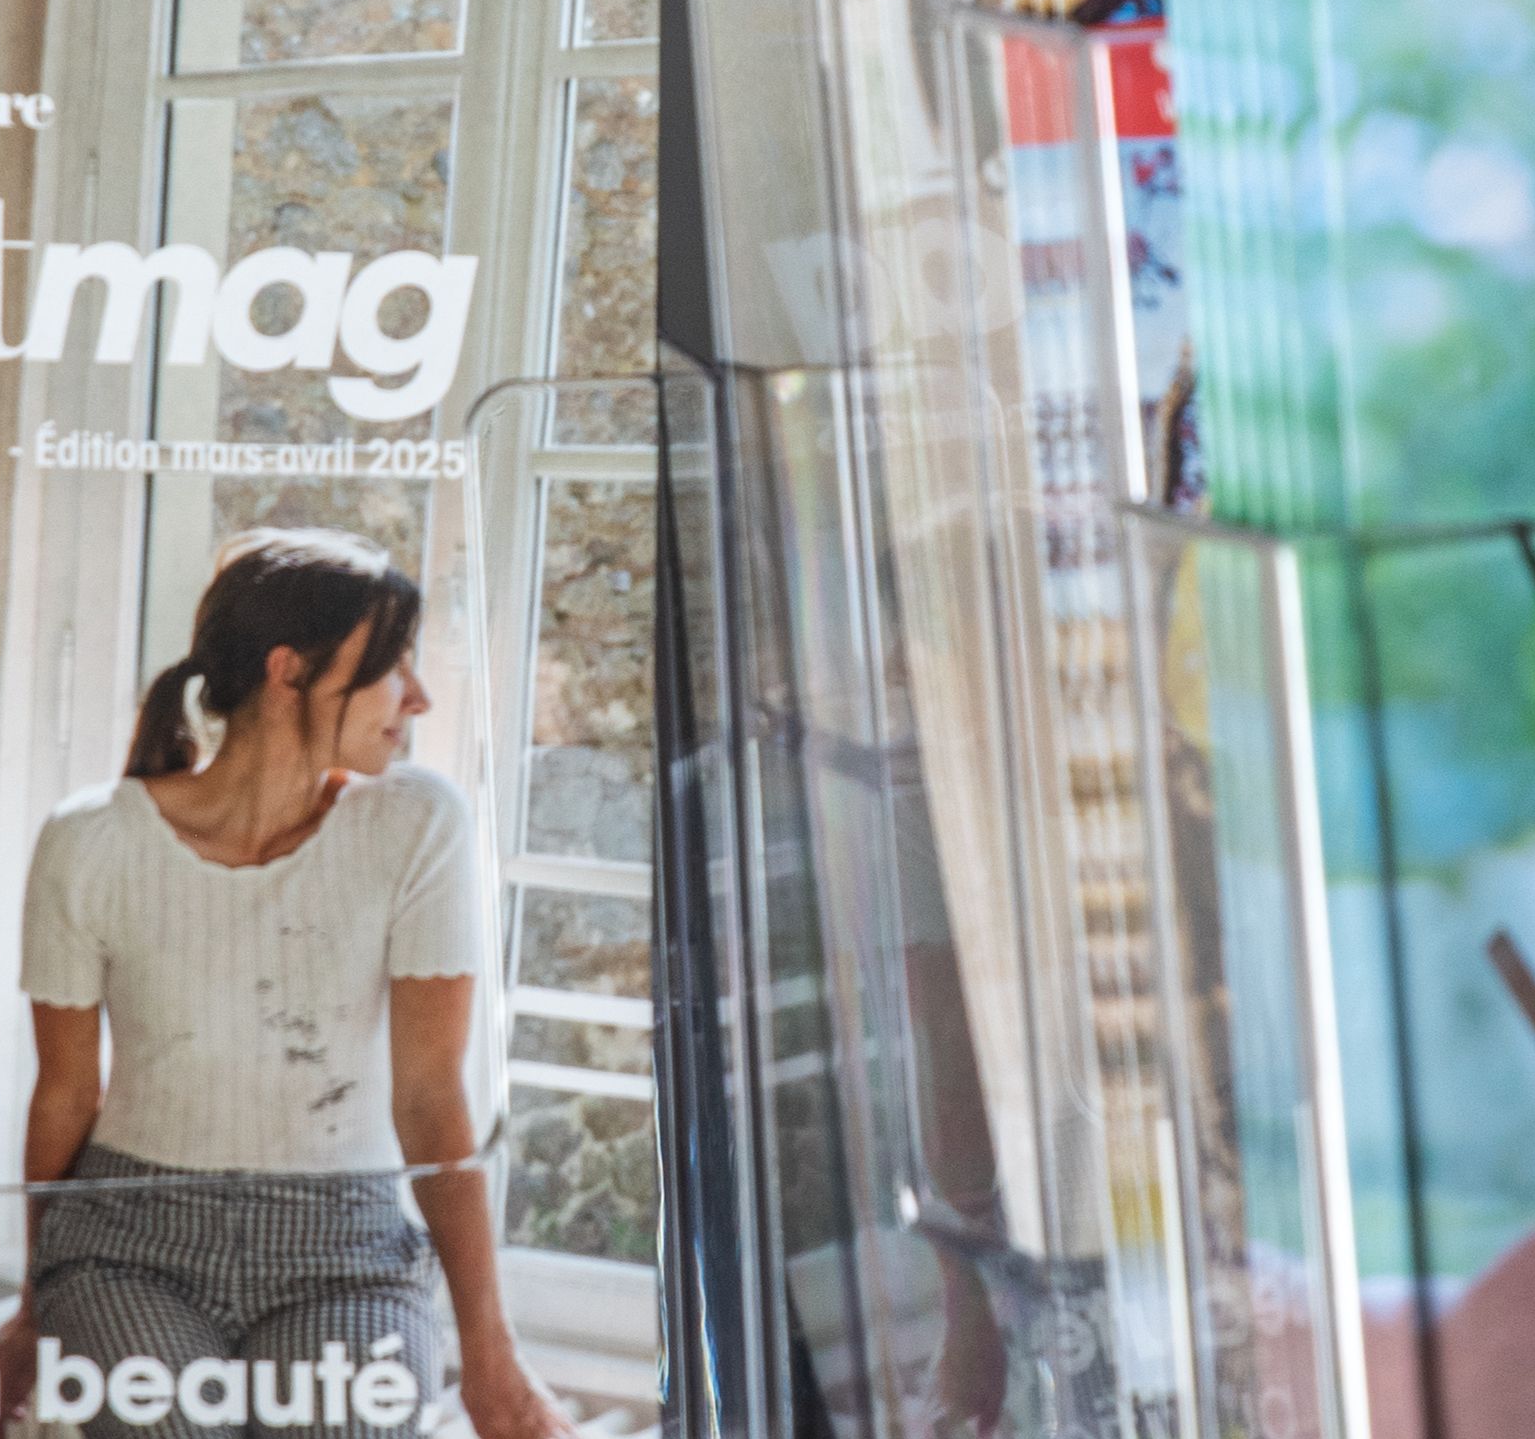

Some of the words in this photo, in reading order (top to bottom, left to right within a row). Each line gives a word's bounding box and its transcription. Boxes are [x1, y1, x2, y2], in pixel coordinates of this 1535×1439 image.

[35, 420, 157, 474] Édition
[170, 437, 354, 477] mars-avril
[368, 439, 465, 481] 2025
[36, 1333, 438, 1433] beauté,
